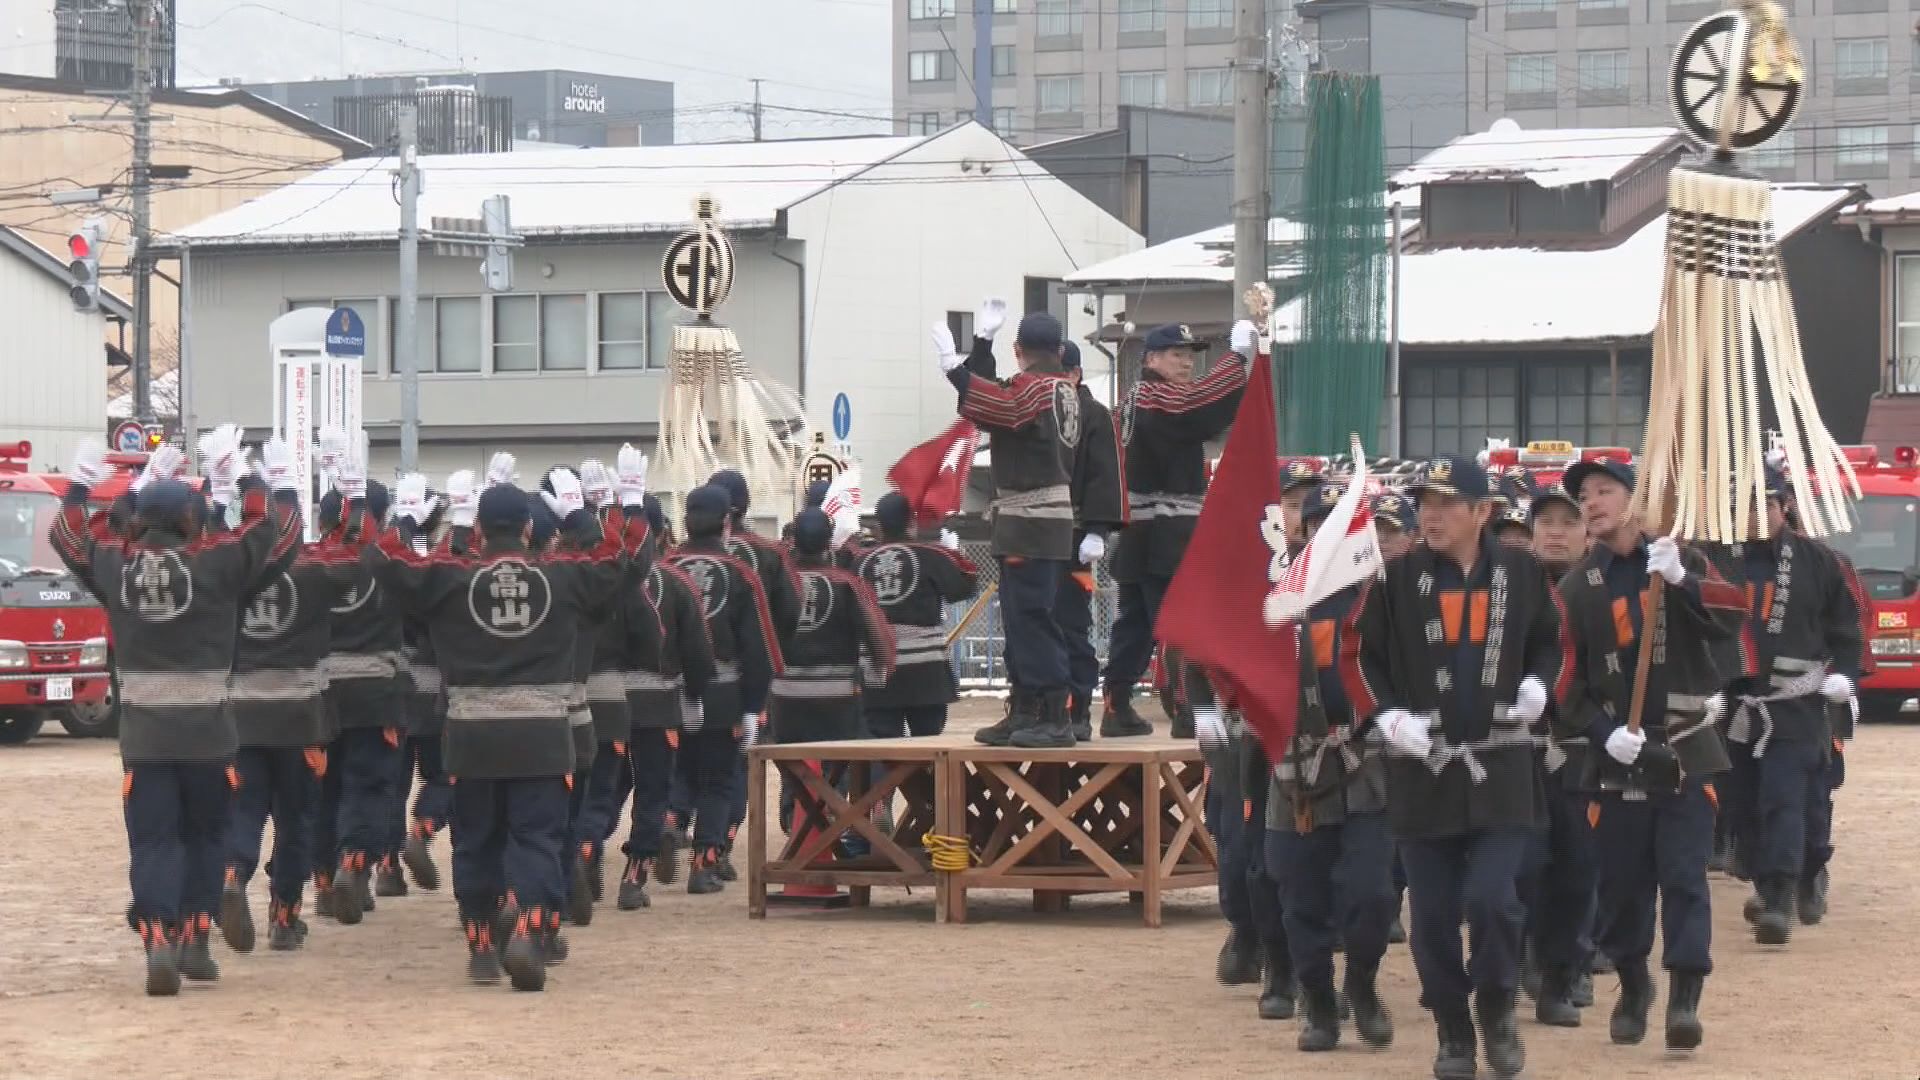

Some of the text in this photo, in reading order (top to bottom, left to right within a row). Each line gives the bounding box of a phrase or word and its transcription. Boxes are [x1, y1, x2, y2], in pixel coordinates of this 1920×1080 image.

[564, 96, 606, 113] around
[571, 80, 598, 97] hotel
[134, 550, 177, 613] 高山
[873, 550, 904, 599] 高山
[39, 591, 71, 600] ISUZU
[489, 564, 531, 626] 高山
